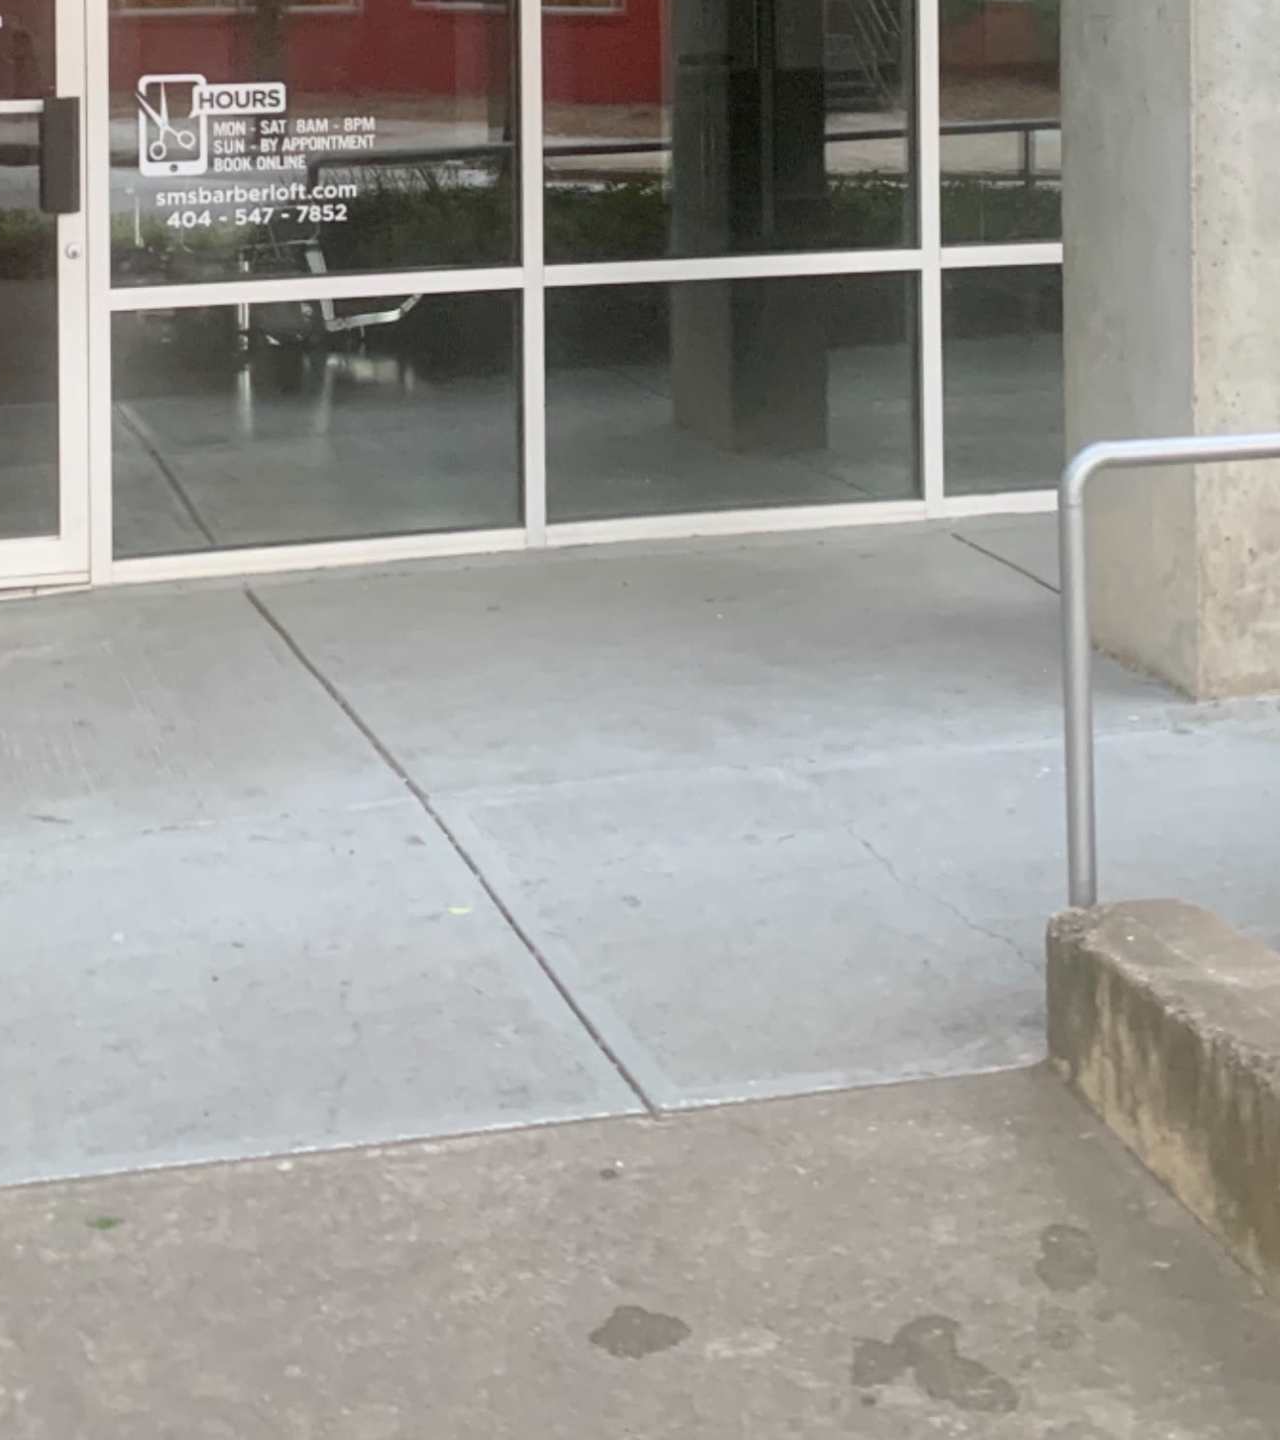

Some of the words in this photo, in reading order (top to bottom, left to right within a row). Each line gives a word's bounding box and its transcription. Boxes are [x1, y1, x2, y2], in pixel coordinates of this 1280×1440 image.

[199, 89, 281, 109] HOURS
[213, 120, 246, 137] MON
[260, 119, 287, 135] SAT
[296, 118, 329, 133] 8AM
[343, 116, 376, 132] 8PM
[213, 139, 245, 155] SUN
[260, 137, 278, 152] BY
[282, 134, 376, 152] APPOINTMENT
[213, 157, 252, 172] BOOK
[256, 154, 307, 170] ONLINE
[156, 182, 357, 207] smsbarberloft.com
[167, 210, 212, 228] 404
[235, 207, 274, 226] 547
[296, 204, 347, 223] 7852
